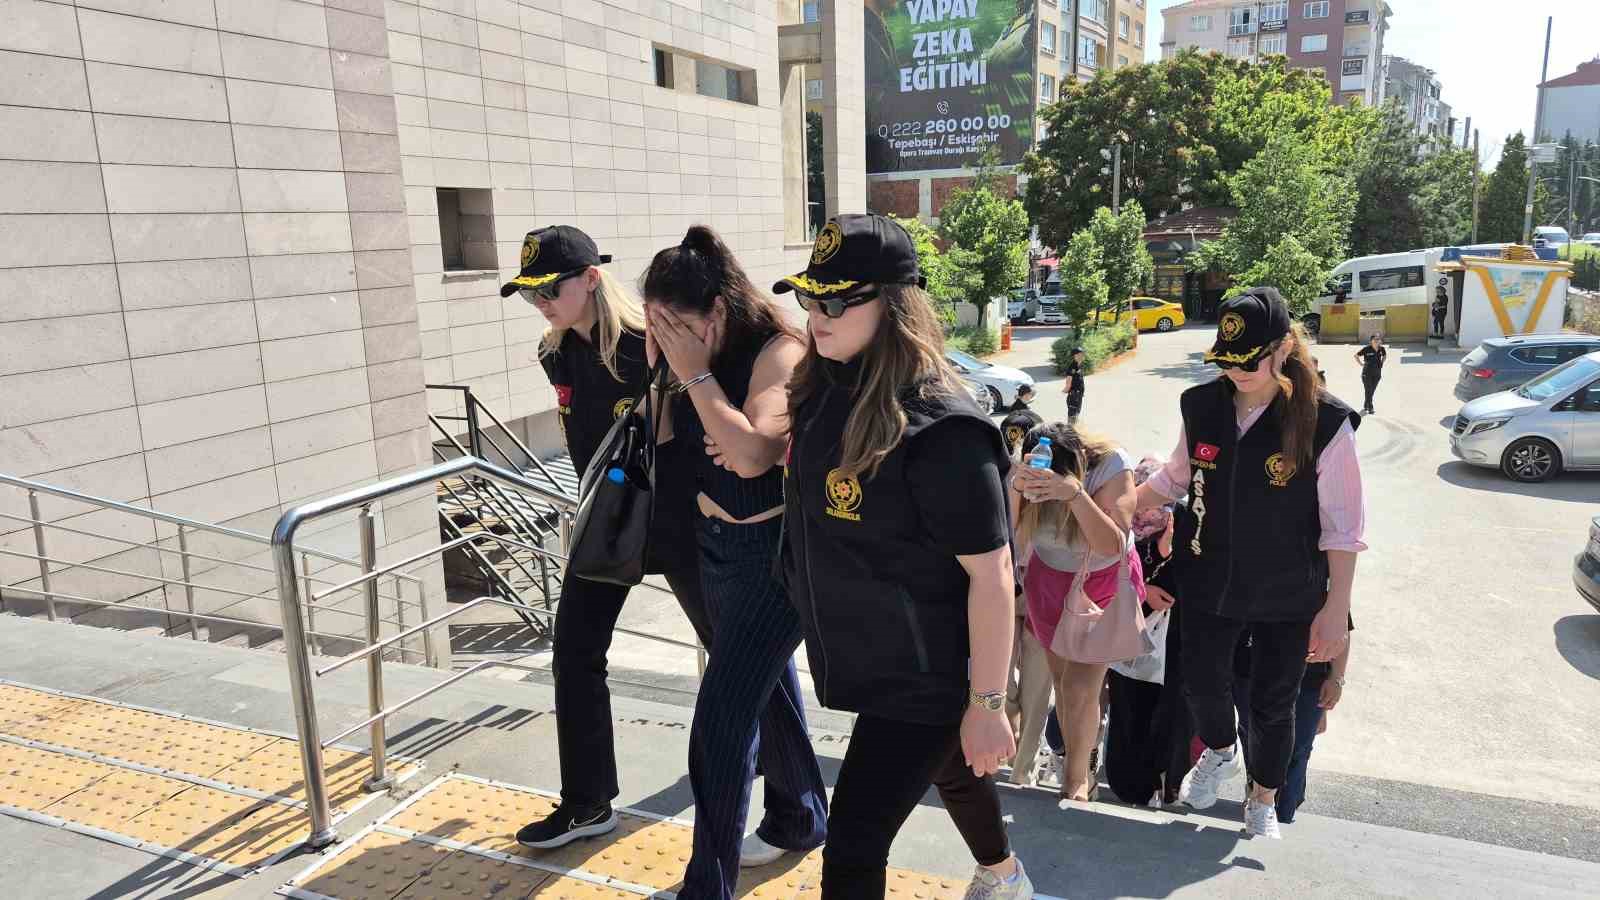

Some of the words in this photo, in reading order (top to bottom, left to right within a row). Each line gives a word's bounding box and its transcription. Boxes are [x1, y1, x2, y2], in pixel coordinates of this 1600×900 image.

[906, 0, 978, 24] YAPAY
[912, 27, 974, 58] ZEKA
[899, 54, 987, 93] EĞİTİMİ
[878, 124, 888, 138] 0
[892, 121, 921, 137] 222
[925, 119, 957, 134] 260
[961, 117, 983, 131] 00
[987, 114, 1010, 129] 00
[888, 137, 937, 149] Tepebaşı
